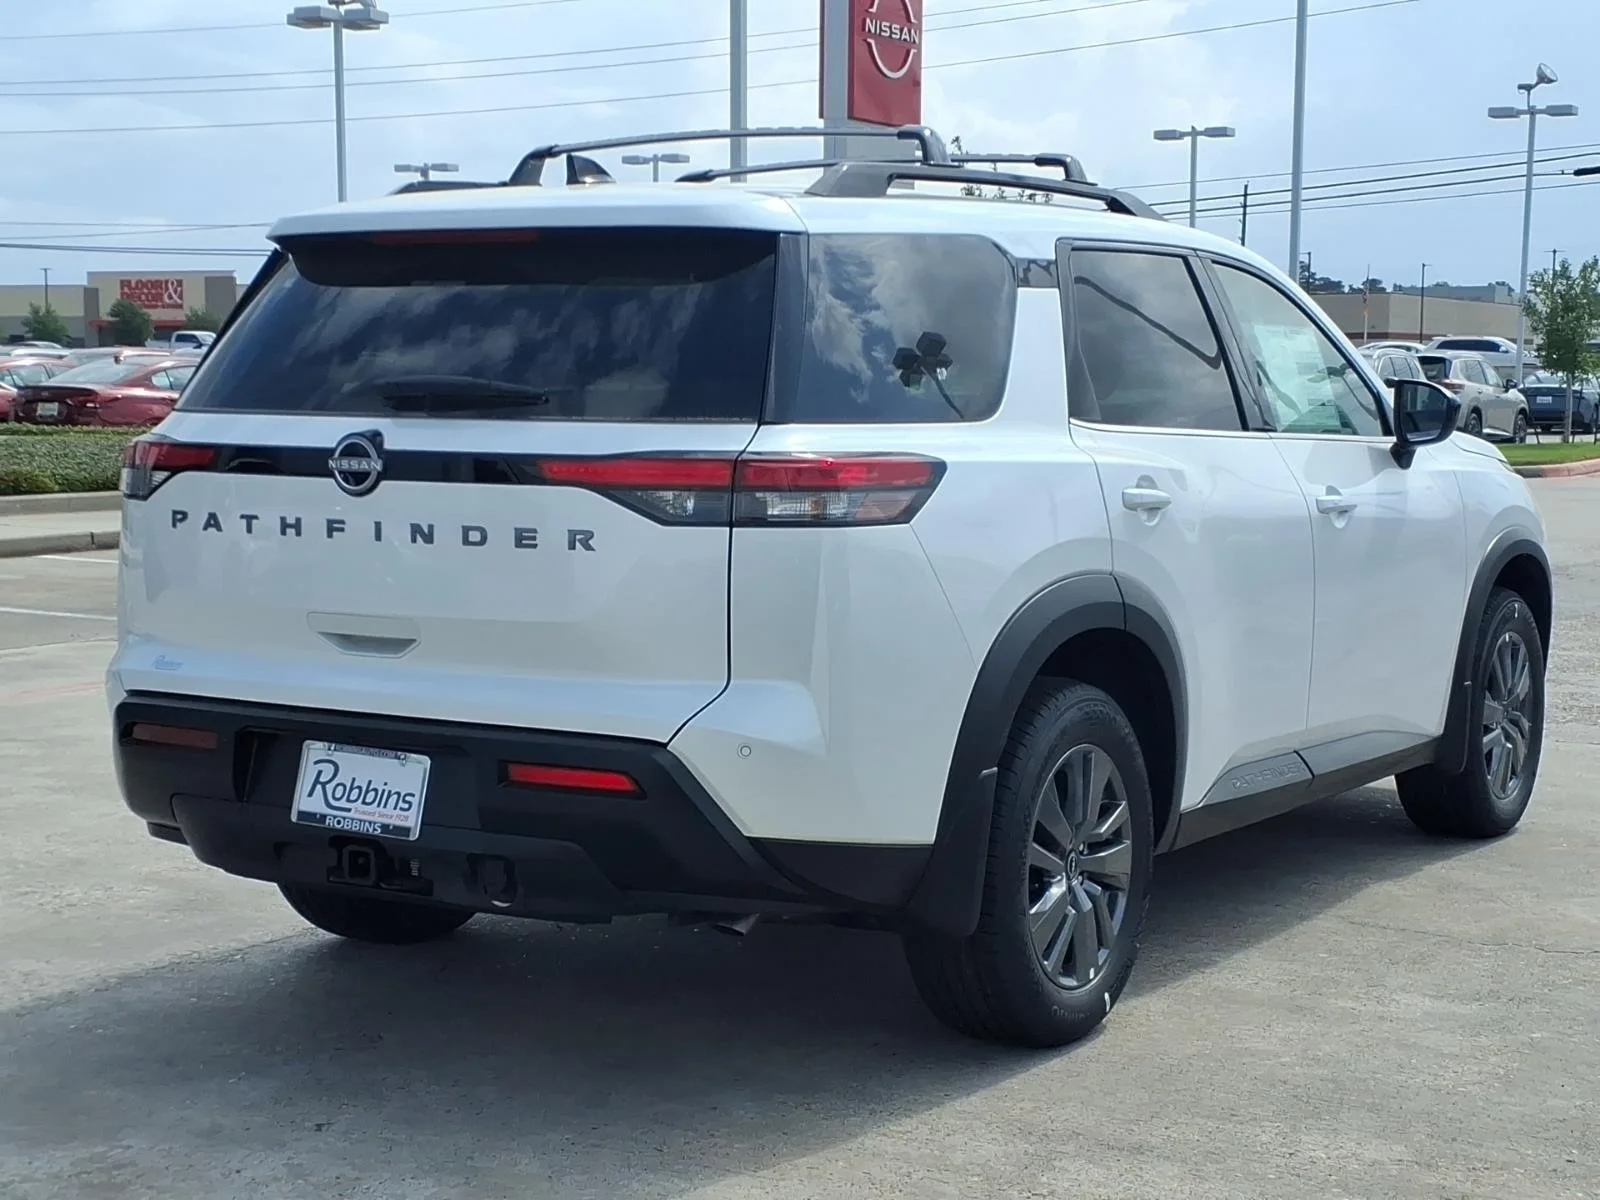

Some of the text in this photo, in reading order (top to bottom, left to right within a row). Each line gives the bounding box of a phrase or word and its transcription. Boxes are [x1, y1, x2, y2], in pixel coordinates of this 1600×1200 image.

[865, 18, 919, 44] NISSAN
[120, 279, 184, 304] FLOOR &
[328, 459, 383, 472] NISSAN
[171, 509, 596, 551] PATHFINDER
[307, 758, 416, 813] Robbins
[325, 816, 382, 834] ROBBINS
